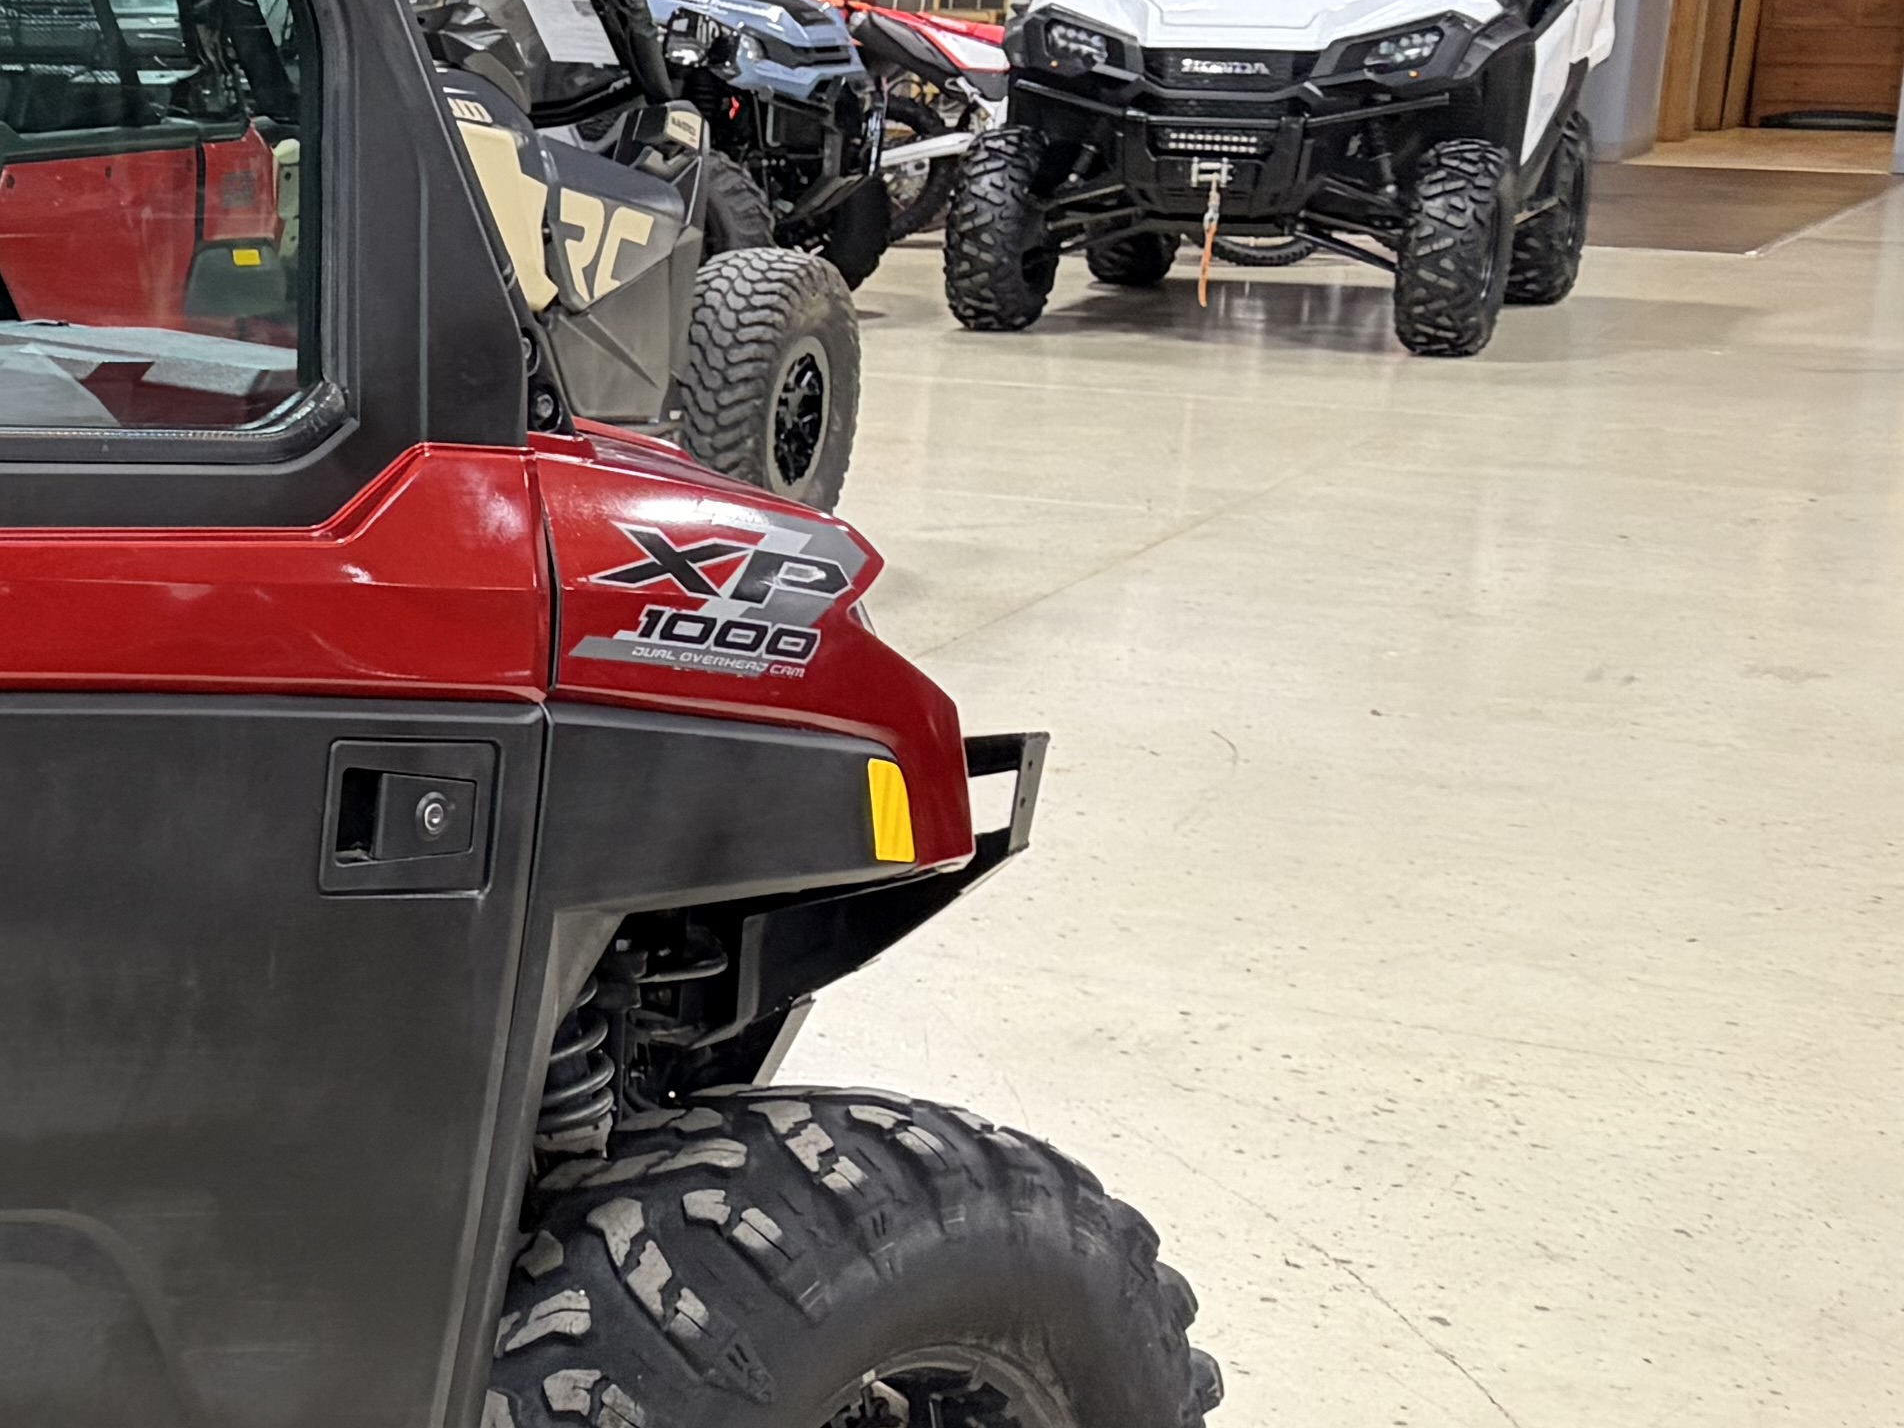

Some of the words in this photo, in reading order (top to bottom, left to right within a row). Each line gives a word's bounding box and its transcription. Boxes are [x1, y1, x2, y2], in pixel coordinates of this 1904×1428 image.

[588, 521, 853, 606] XP
[631, 646, 676, 661] DUAL
[679, 652, 769, 672] OVERHEAD
[769, 664, 806, 678] CAM
[636, 604, 822, 664] 1000
